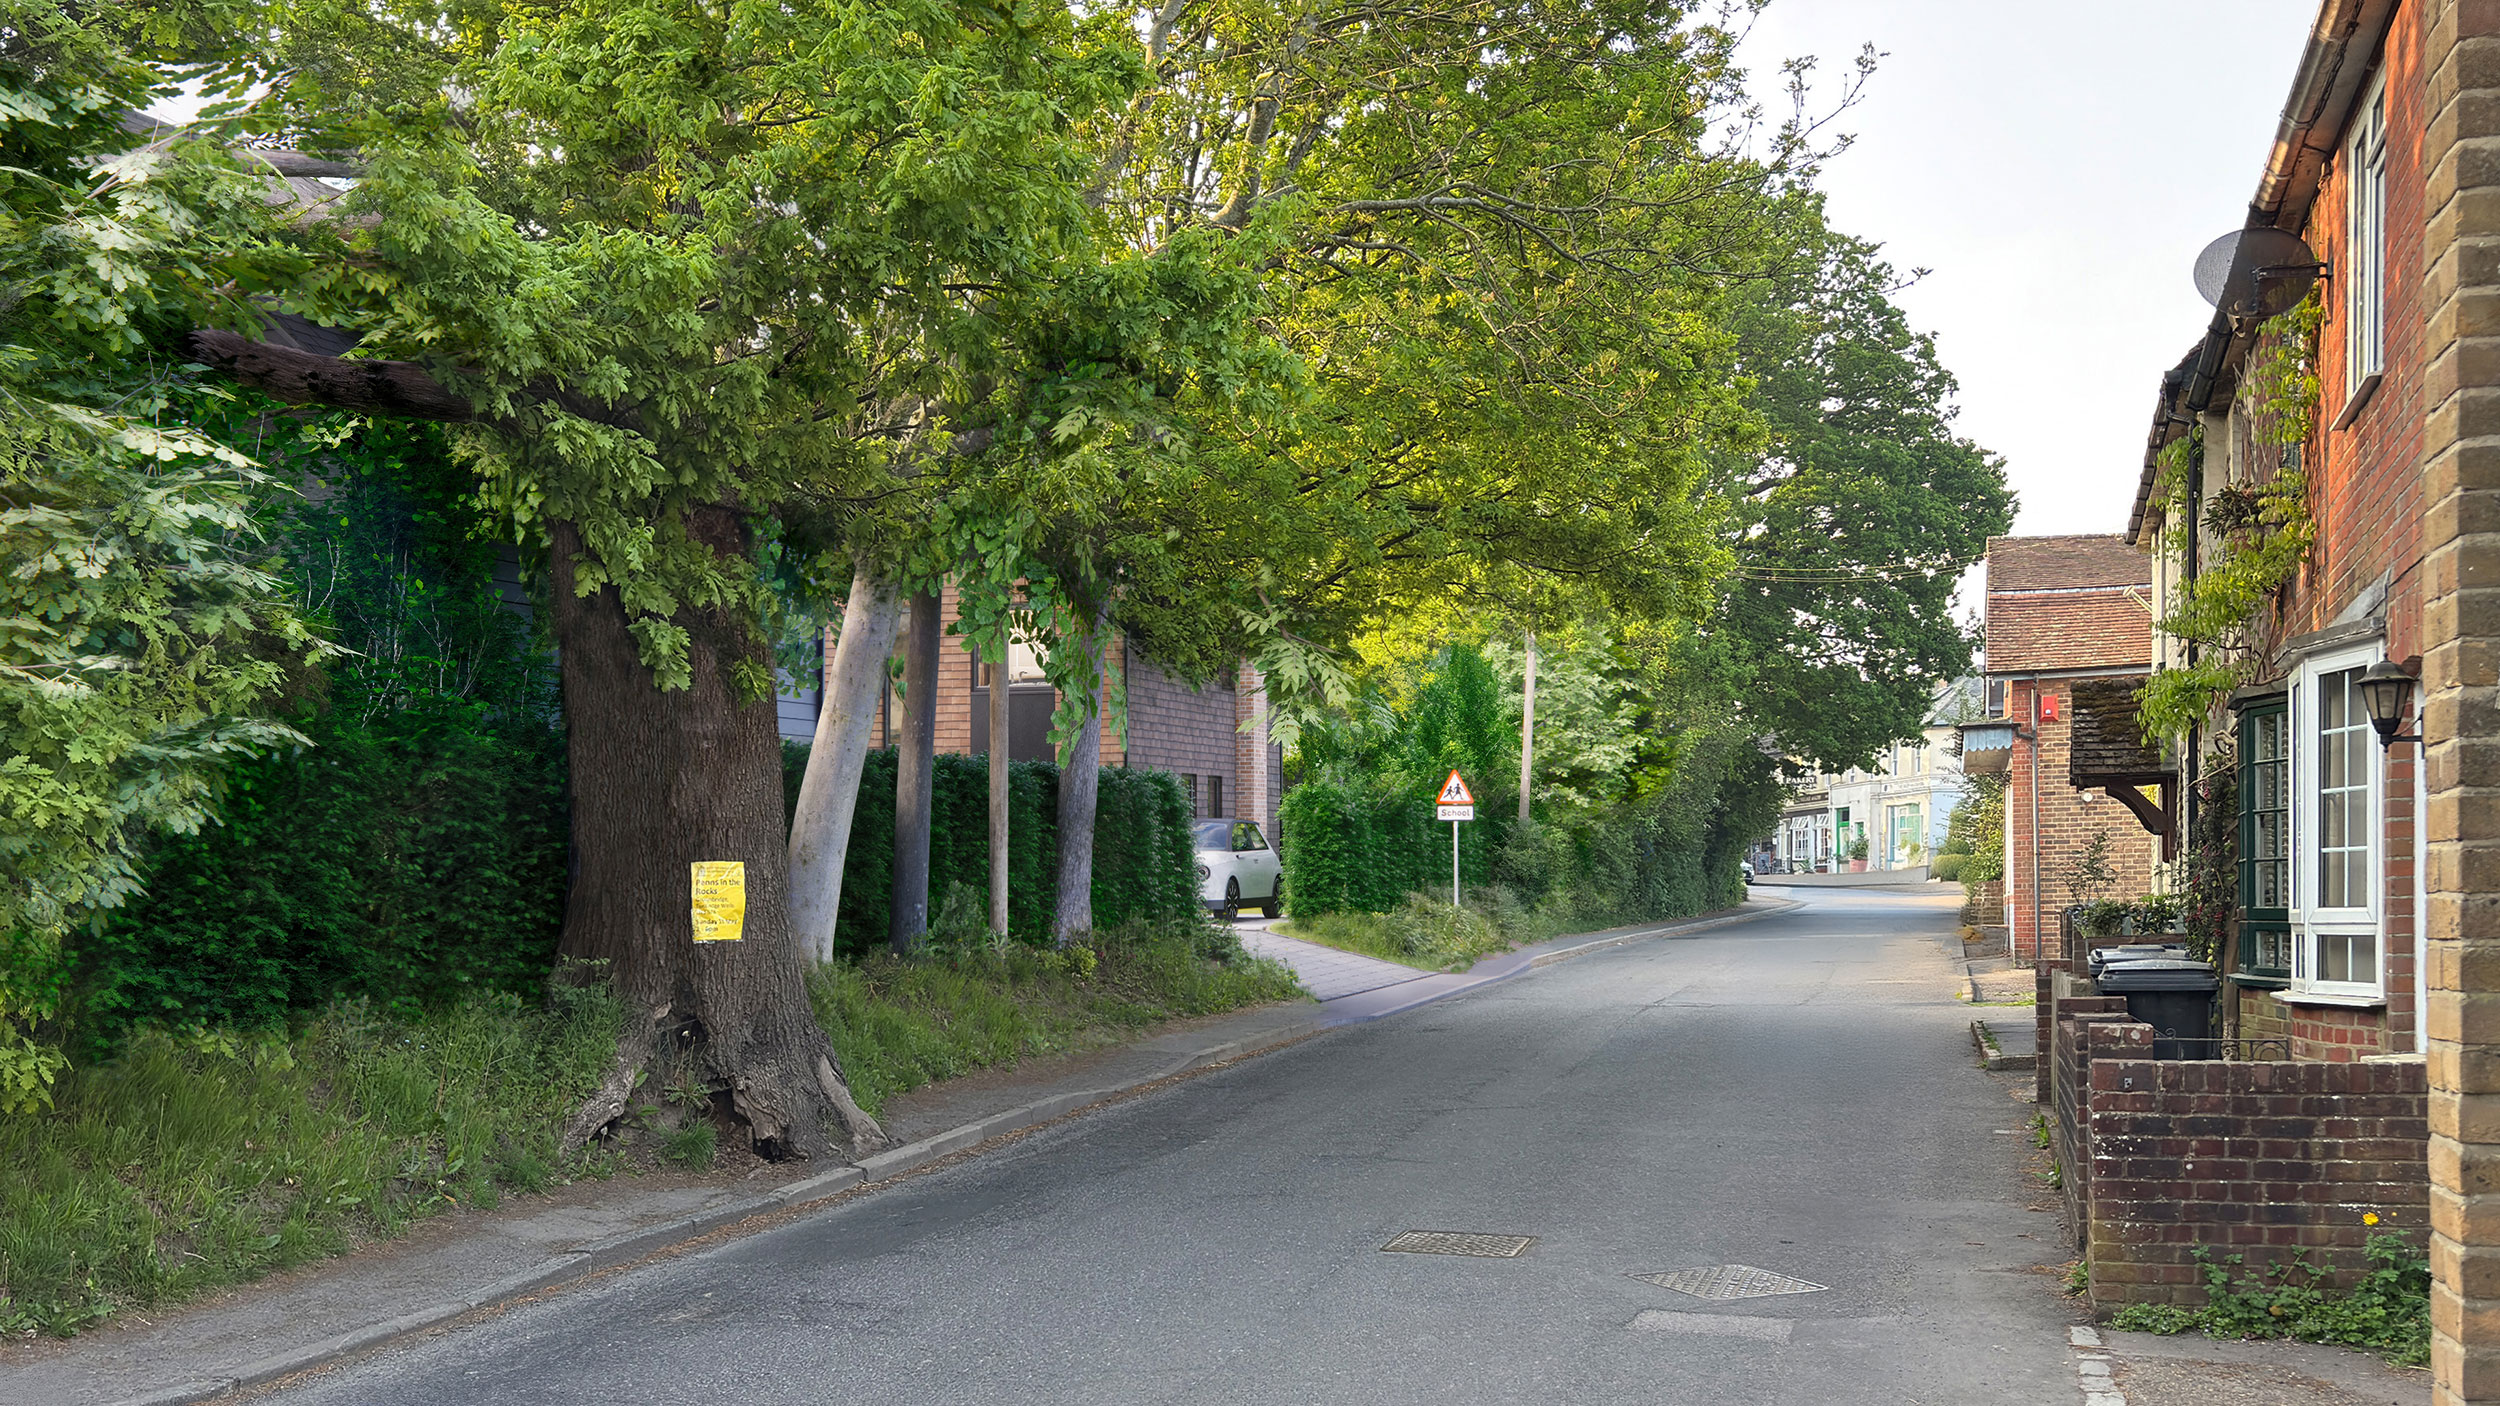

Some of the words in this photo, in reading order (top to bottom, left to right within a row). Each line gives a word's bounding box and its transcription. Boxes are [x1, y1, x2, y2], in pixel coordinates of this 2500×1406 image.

[1441, 809, 1470, 817] School
[720, 878, 728, 886] in
[729, 878, 741, 886] the
[695, 887, 718, 895] Rocks
